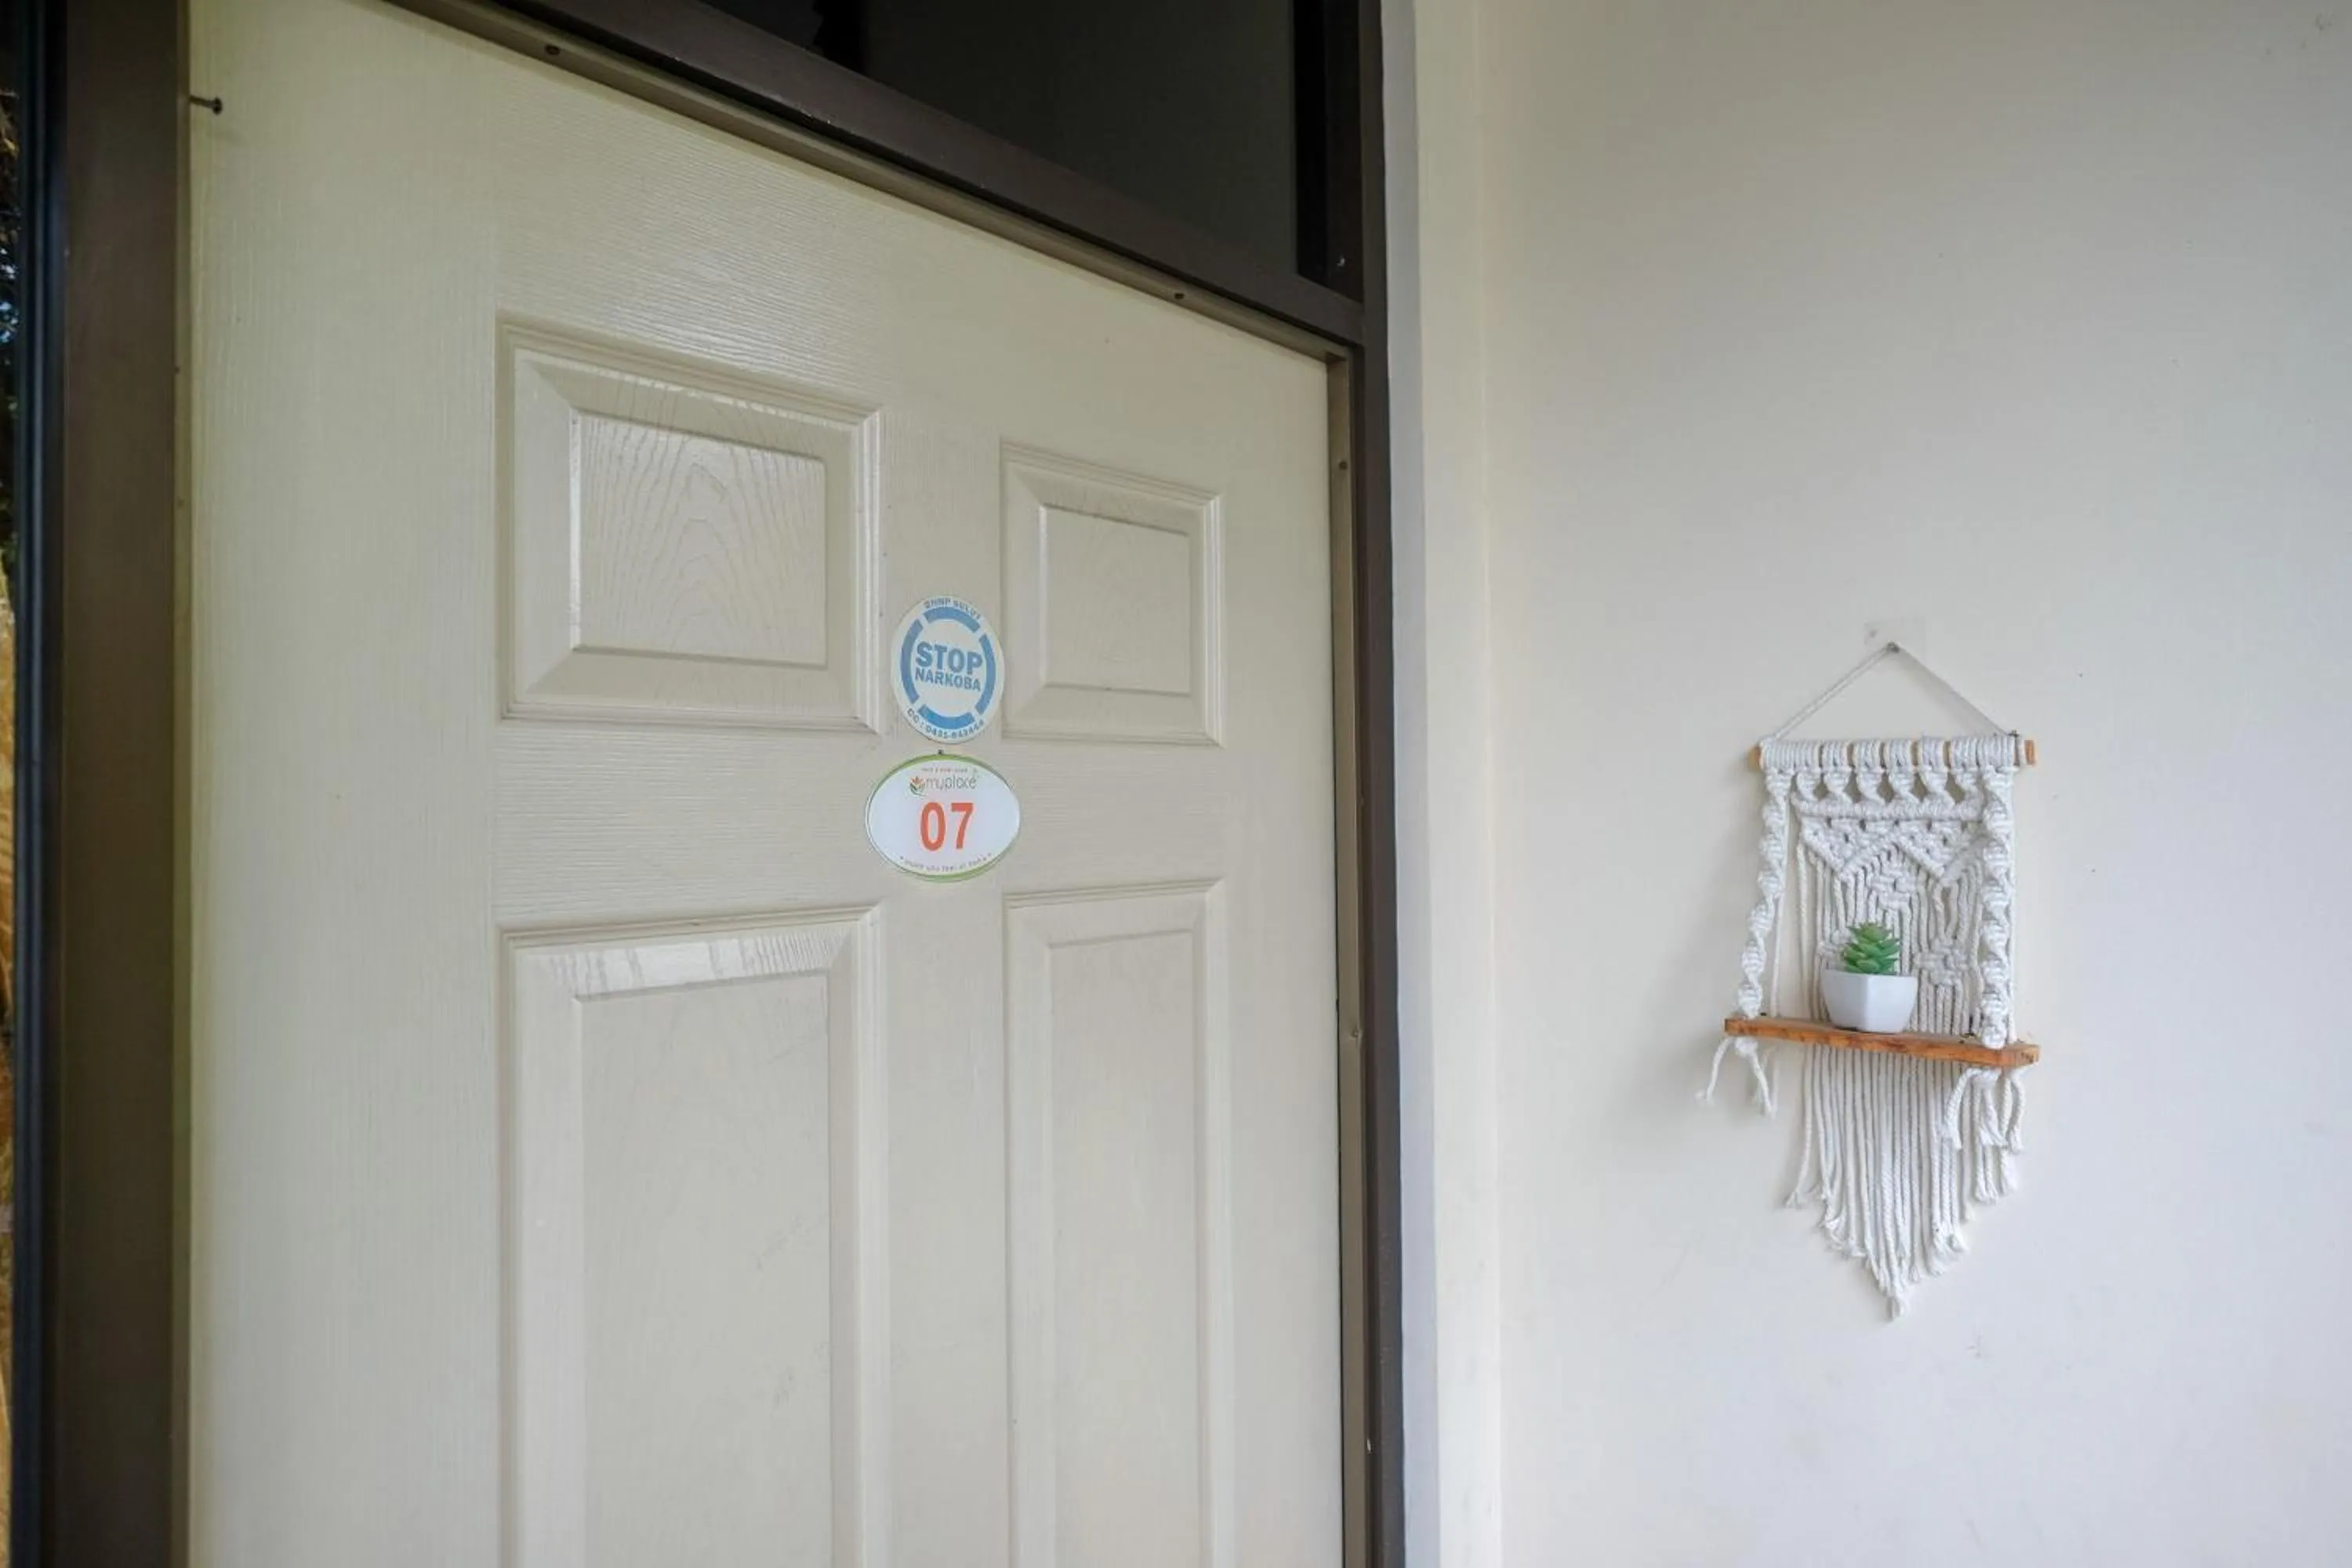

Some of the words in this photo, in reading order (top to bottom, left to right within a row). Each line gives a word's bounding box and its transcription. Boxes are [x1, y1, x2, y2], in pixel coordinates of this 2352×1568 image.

[915, 641, 983, 675] STOP
[915, 667, 981, 691] NARKOBA
[920, 801, 975, 851] 07
